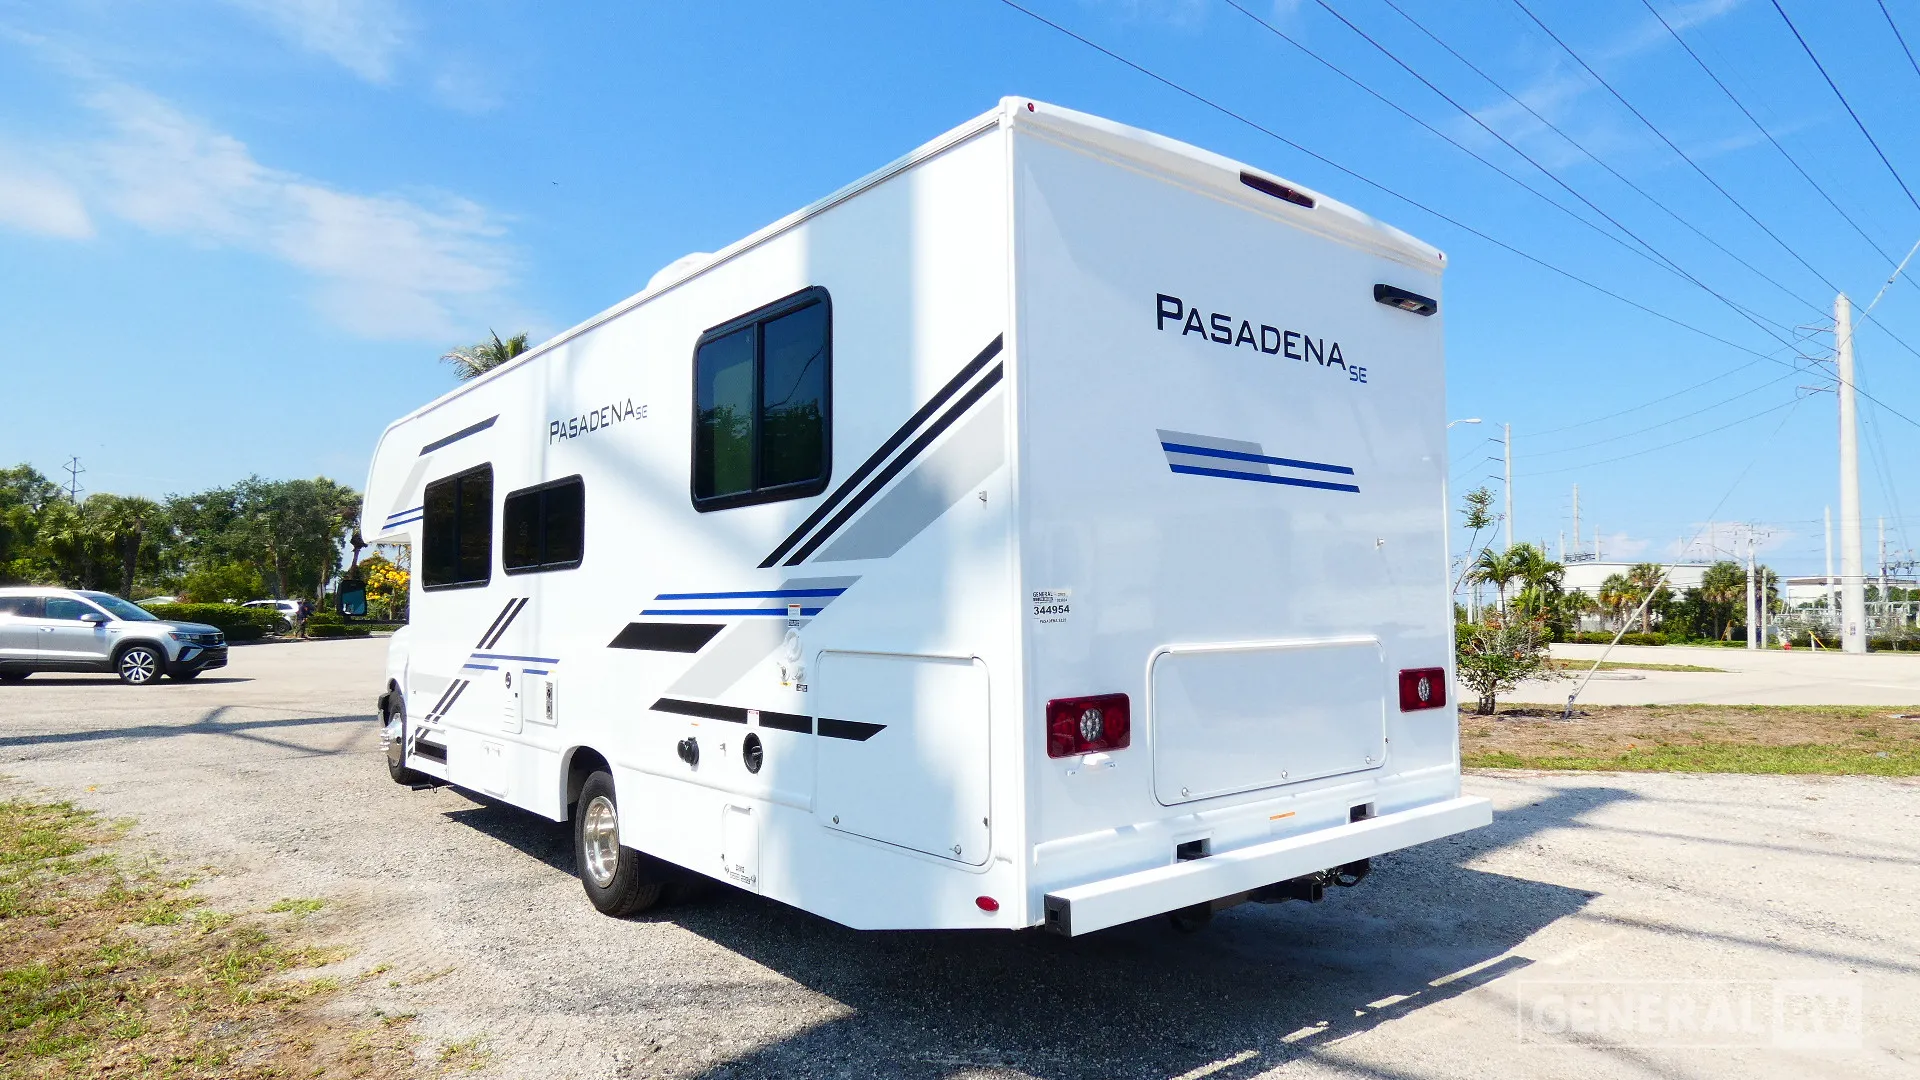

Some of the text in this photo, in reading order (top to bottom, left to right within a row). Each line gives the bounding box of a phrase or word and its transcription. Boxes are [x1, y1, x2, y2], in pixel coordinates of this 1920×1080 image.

[1156, 292, 1368, 384] PASADENA SE
[549, 397, 648, 445] PASADENA SE
[1034, 605, 1069, 615] 344954
